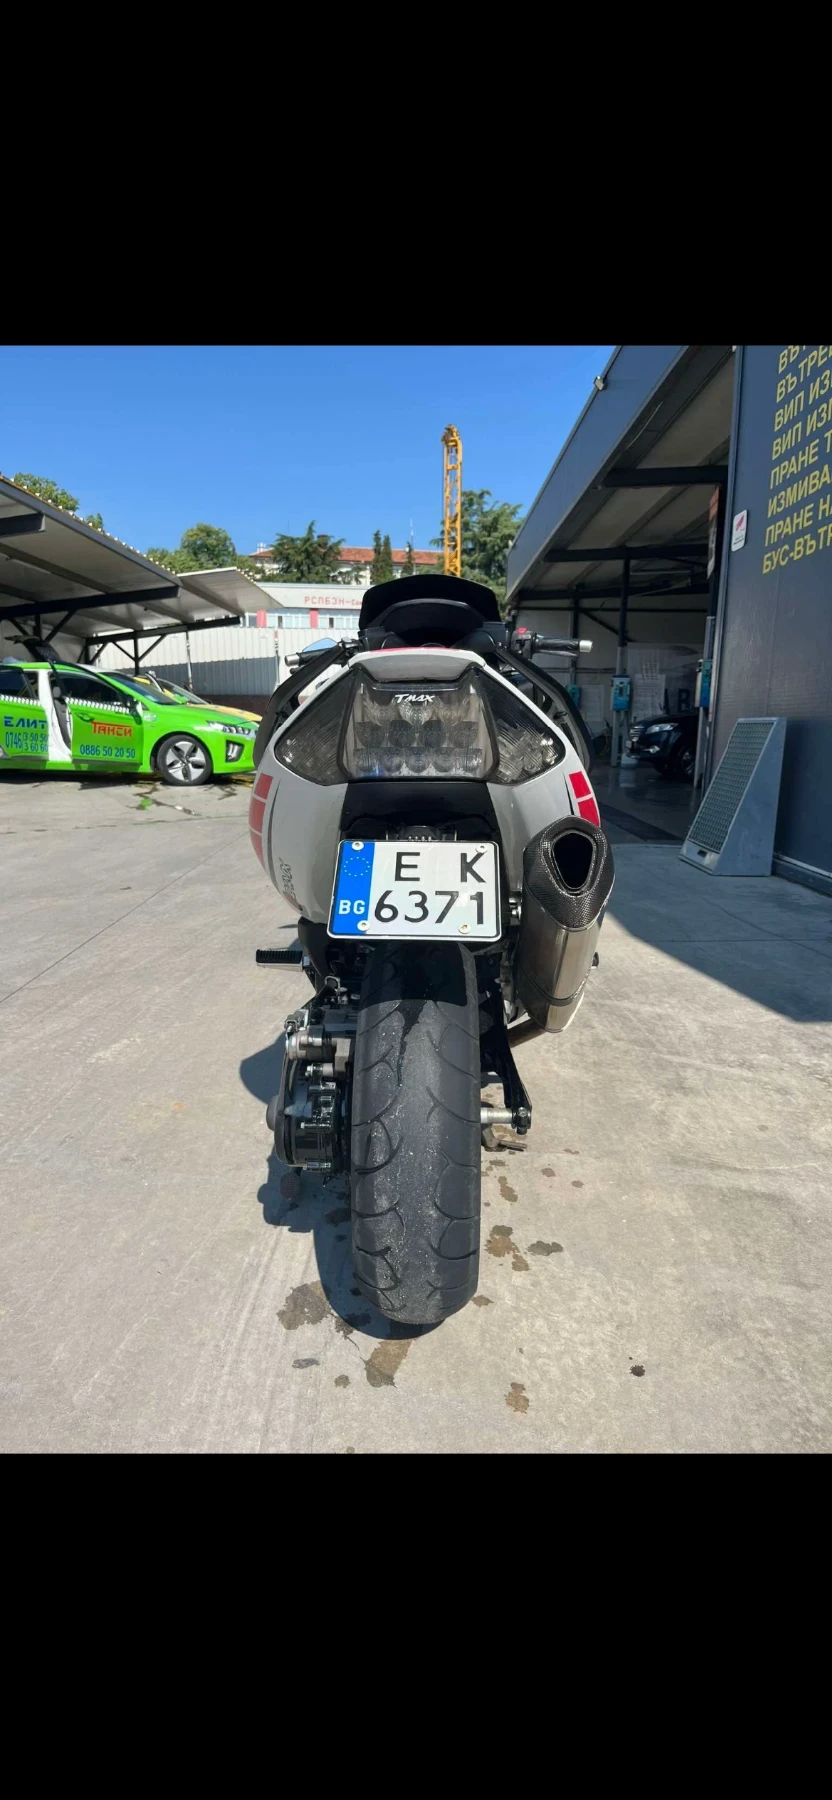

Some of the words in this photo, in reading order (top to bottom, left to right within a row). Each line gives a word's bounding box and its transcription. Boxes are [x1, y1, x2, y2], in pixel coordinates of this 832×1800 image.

[778, 345, 806, 374] ВЪ
[774, 390, 805, 432] ВИП
[808, 369, 832, 405] ИЗ
[771, 421, 802, 461] ВИП
[769, 438, 820, 490] ПРАНЕ
[767, 464, 832, 518] ИЗМИВА
[764, 503, 815, 547] ПРАНЕ
[818, 494, 832, 520] Н
[394, 693, 436, 704] TMAX
[3, 716, 48, 729] ЕЛИТ
[80, 744, 100, 756] 0886
[102, 746, 113, 757] 50
[115, 747, 125, 757] 20
[126, 748, 136, 759] 50
[395, 852, 420, 882] E
[460, 852, 486, 883] K
[338, 900, 366, 915] BG
[374, 890, 484, 925] 6371
